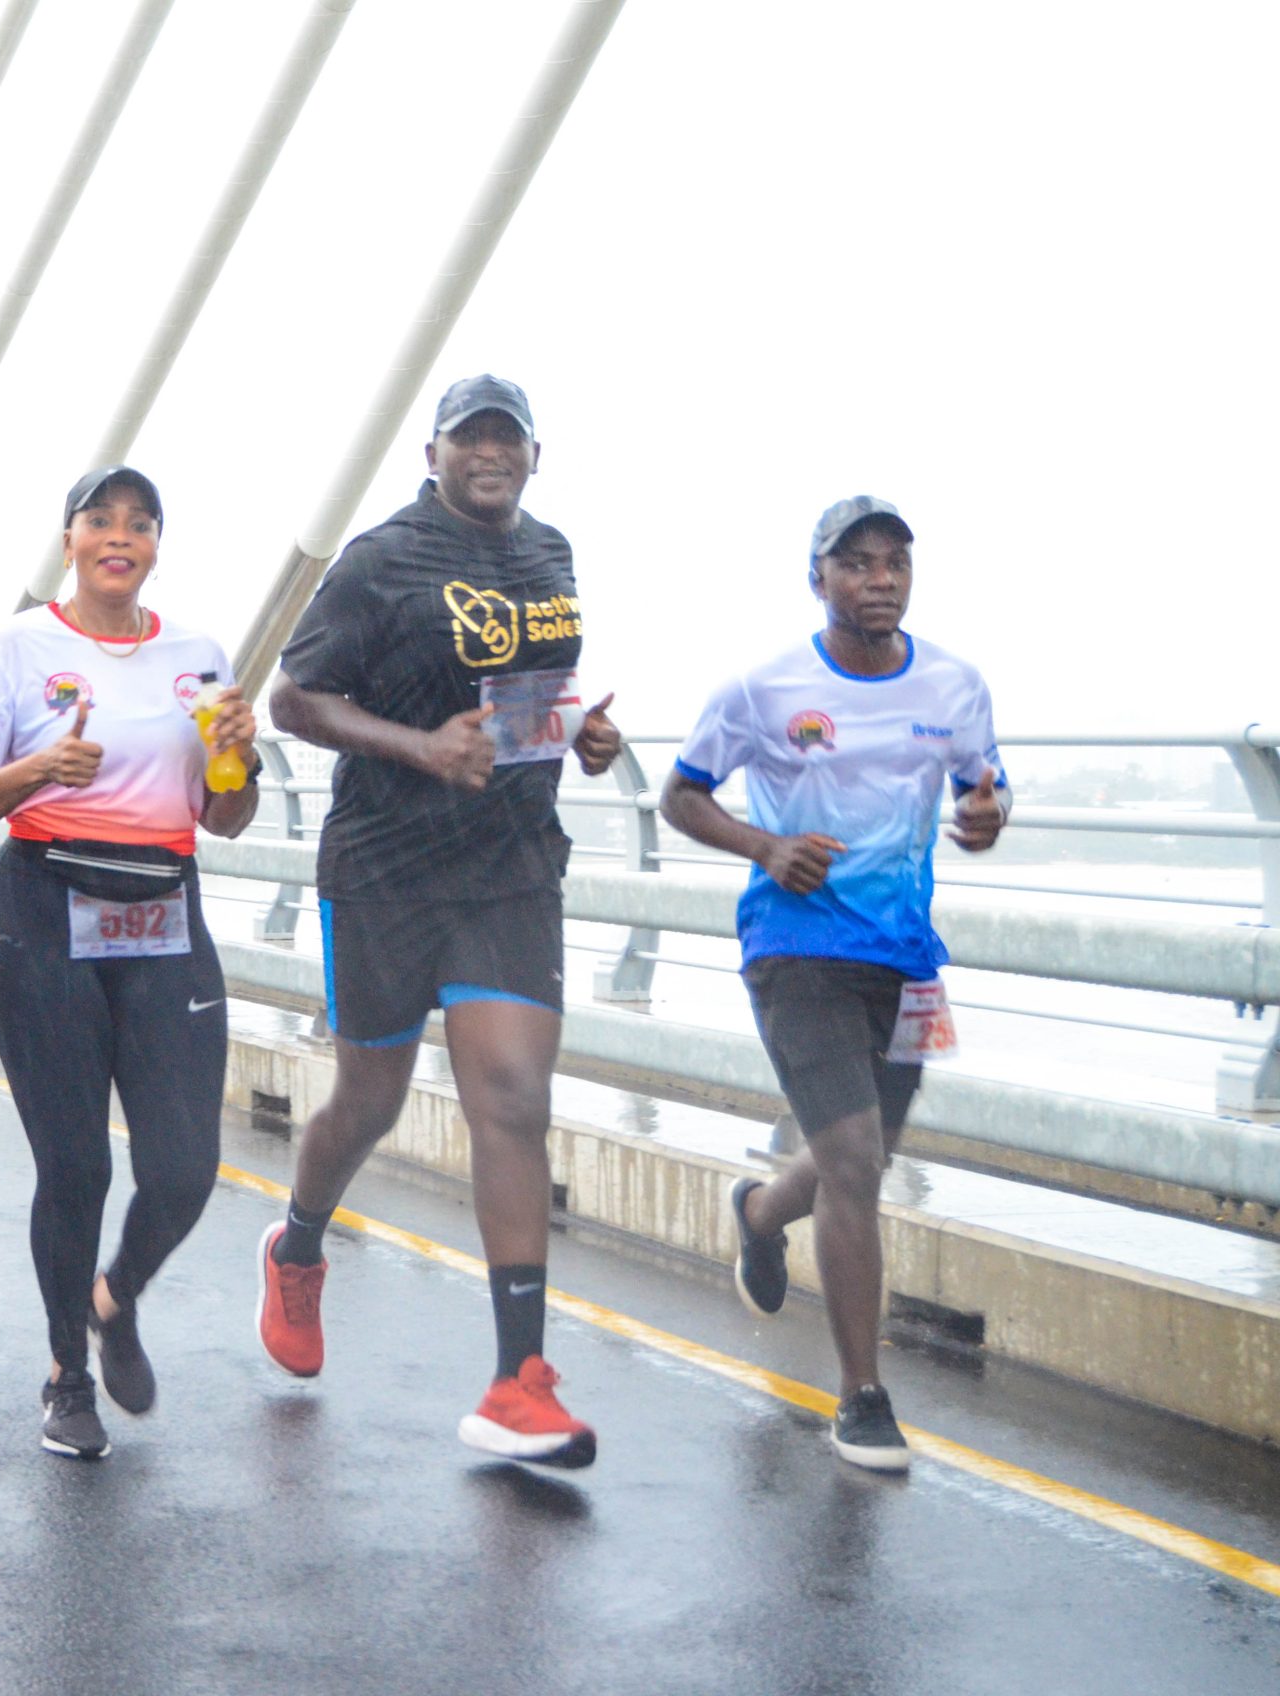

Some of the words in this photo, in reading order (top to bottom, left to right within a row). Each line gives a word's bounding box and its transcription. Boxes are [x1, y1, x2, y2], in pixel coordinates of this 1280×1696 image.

[524, 594, 579, 619] Activ
[527, 617, 582, 642] Soles
[100, 903, 167, 939] 592
